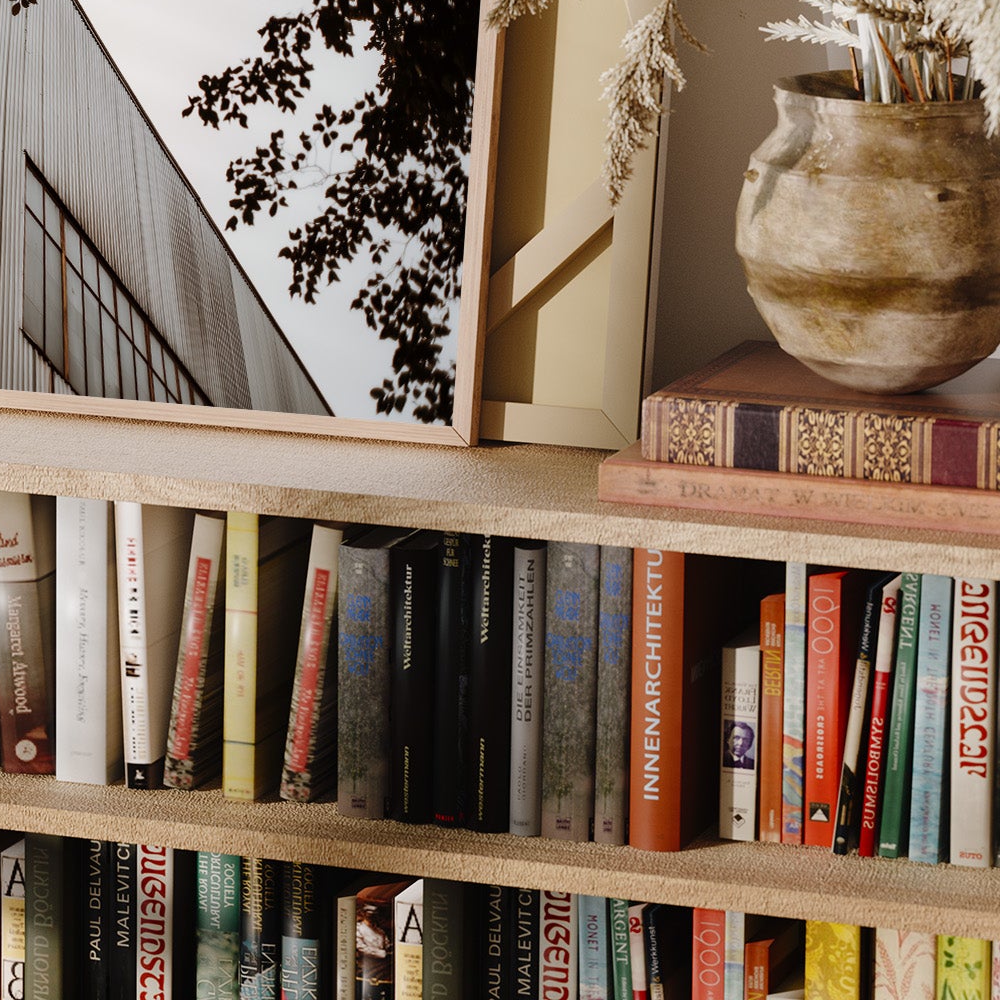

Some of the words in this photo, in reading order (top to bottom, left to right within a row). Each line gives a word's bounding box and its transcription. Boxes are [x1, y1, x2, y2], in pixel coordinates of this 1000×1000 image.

[6, 595, 25, 657] Margaret
[403, 563, 413, 670] Weltarchitektur
[516, 575, 526, 687] EINSAMKEIT
[524, 558, 535, 680] PRIMZAHLEN
[13, 660, 32, 715] Atwood
[516, 691, 525, 722] DIE
[524, 685, 535, 723] DER
[643, 548, 663, 802] INNENARCHITEKTU
[90, 840, 102, 910] DELVAU
[89, 916, 101, 962] PAUL
[613, 898, 629, 964] ARGENT
[648, 925, 659, 974] Werkkunst
[695, 920, 721, 987] 1900
